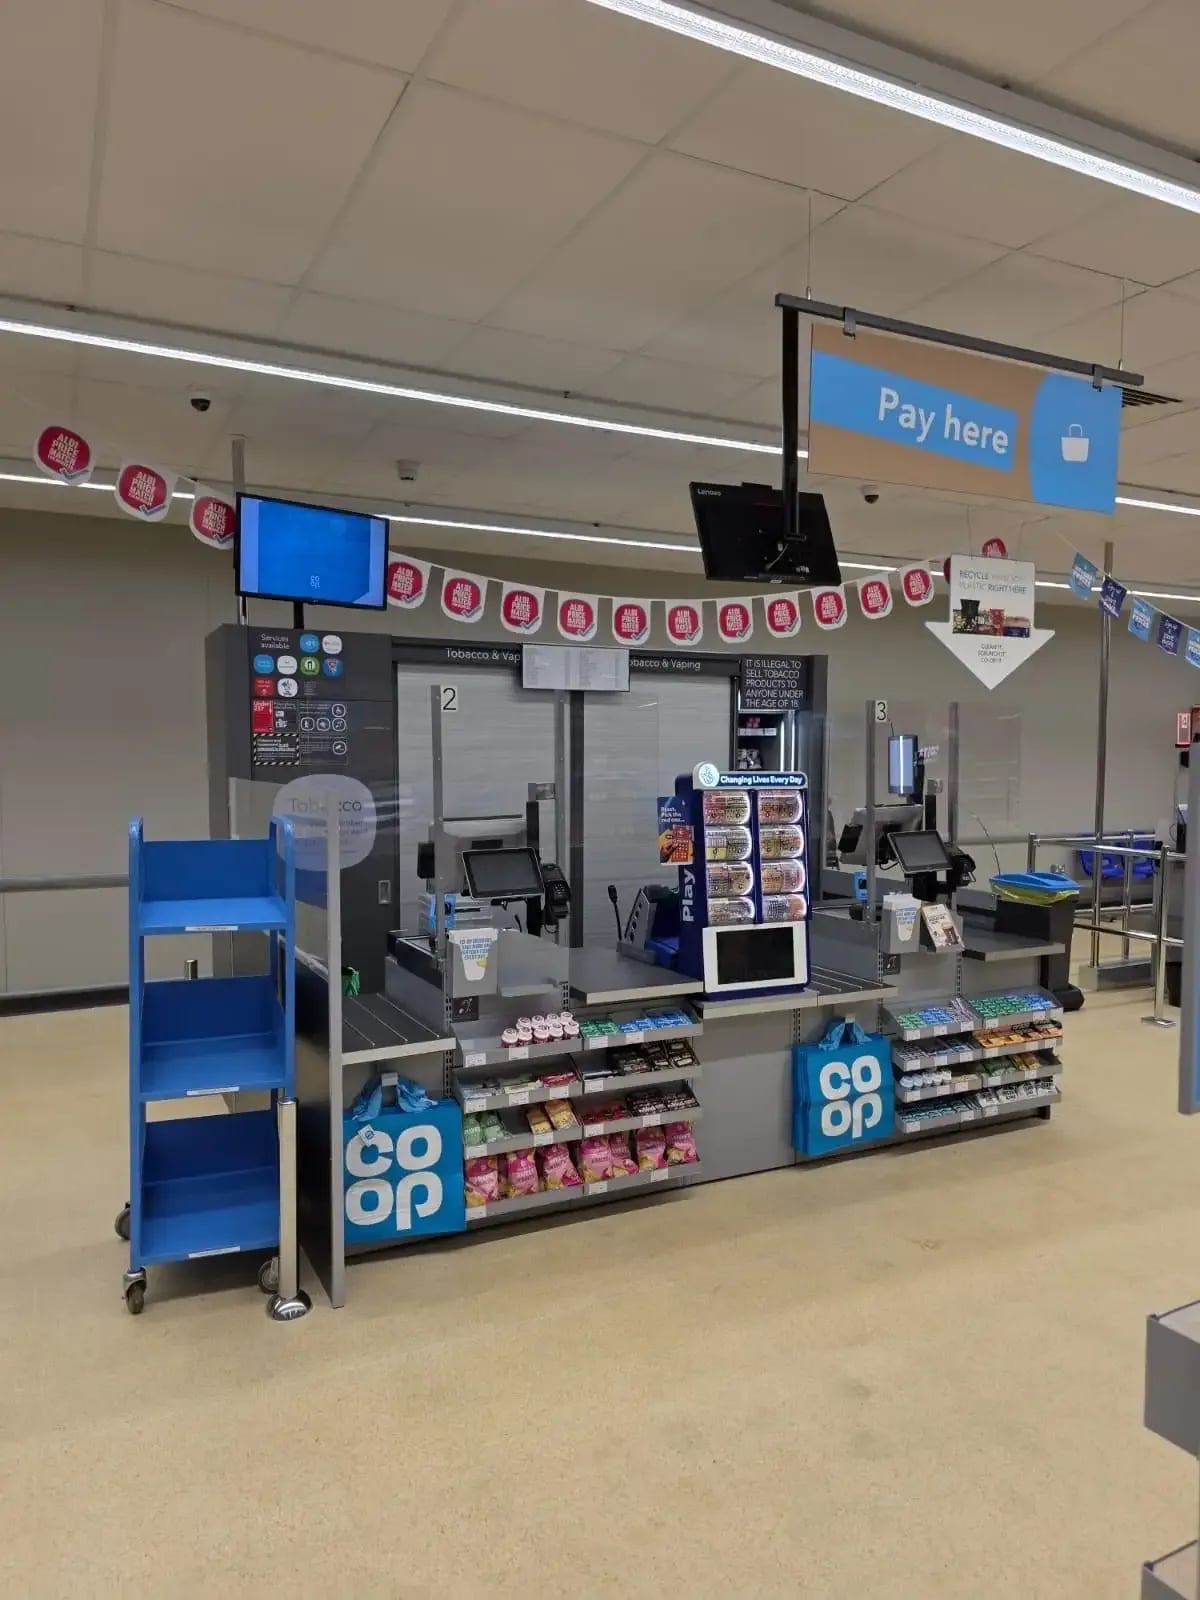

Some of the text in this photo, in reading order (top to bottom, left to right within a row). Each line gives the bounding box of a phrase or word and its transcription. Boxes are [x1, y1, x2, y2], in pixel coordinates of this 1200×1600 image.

[878, 386, 1009, 455] Pay here
[56, 433, 79, 449] ALDI
[51, 439, 80, 458] PRICE
[135, 471, 157, 487] ALDI
[131, 478, 157, 495] PRICE
[959, 569, 989, 581] RECYCLE
[987, 583, 1007, 593] RIGHT
[260, 633, 289, 642] Services
[260, 642, 291, 650] available
[445, 647, 521, 664] Tobacco & Vap
[630, 658, 701, 671] obacco & Vaping
[746, 659, 802, 669] IT IS ILLEGAL TO
[746, 669, 800, 679] SELL TOBACCO
[745, 679, 798, 689] PRODUCTS TO
[443, 687, 457, 711] 2
[745, 689, 803, 699] ANYONE UNDER
[746, 698, 760, 708] THE
[761, 699, 777, 708] AGE
[777, 699, 789, 708] OF
[877, 701, 887, 721] 3
[720, 775, 803, 785] Changing Lives Every Day
[682, 869, 695, 922] Play
